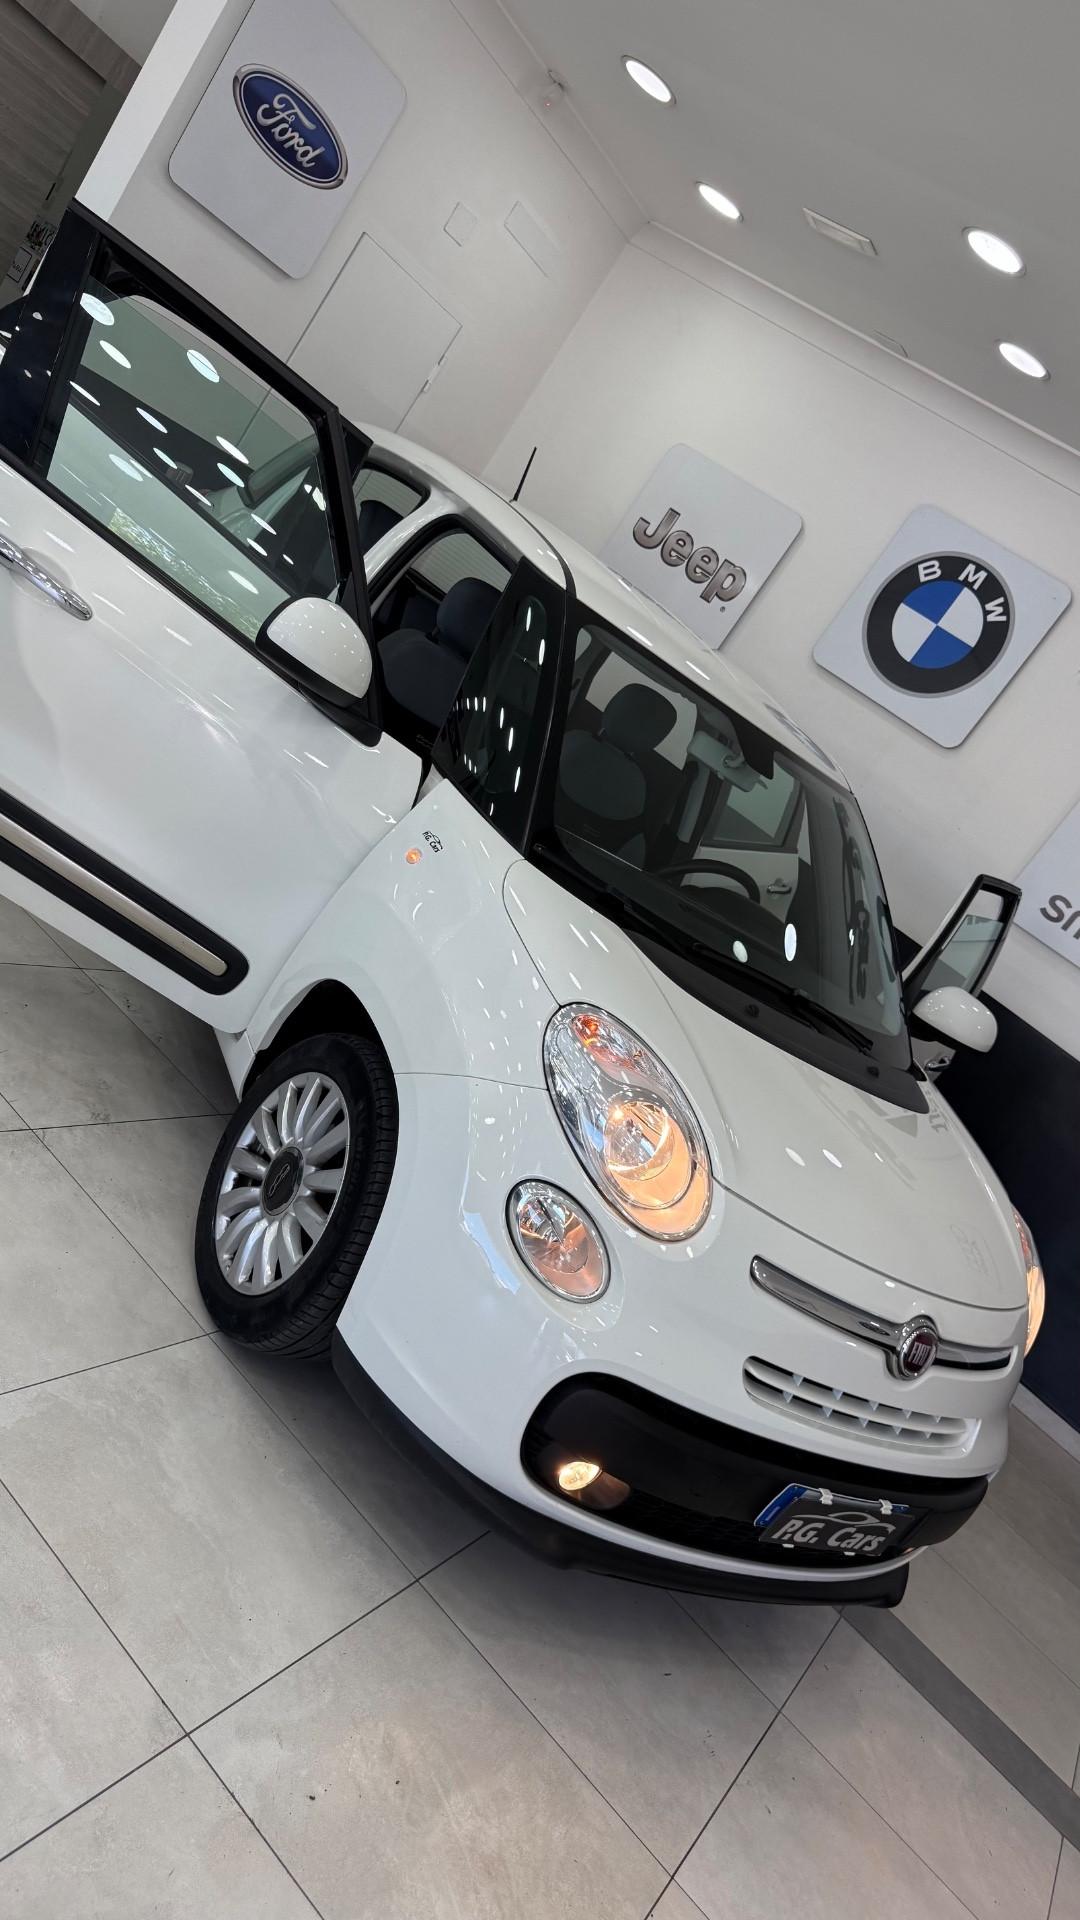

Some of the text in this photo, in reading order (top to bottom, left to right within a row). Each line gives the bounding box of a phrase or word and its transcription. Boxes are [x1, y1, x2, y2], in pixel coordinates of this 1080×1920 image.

[256, 93, 326, 168] Ford
[632, 507, 747, 604] Jeep
[917, 559, 1008, 623] BMW
[907, 1341, 932, 1366] FIAT
[771, 1518, 886, 1551] P.G. Cars
